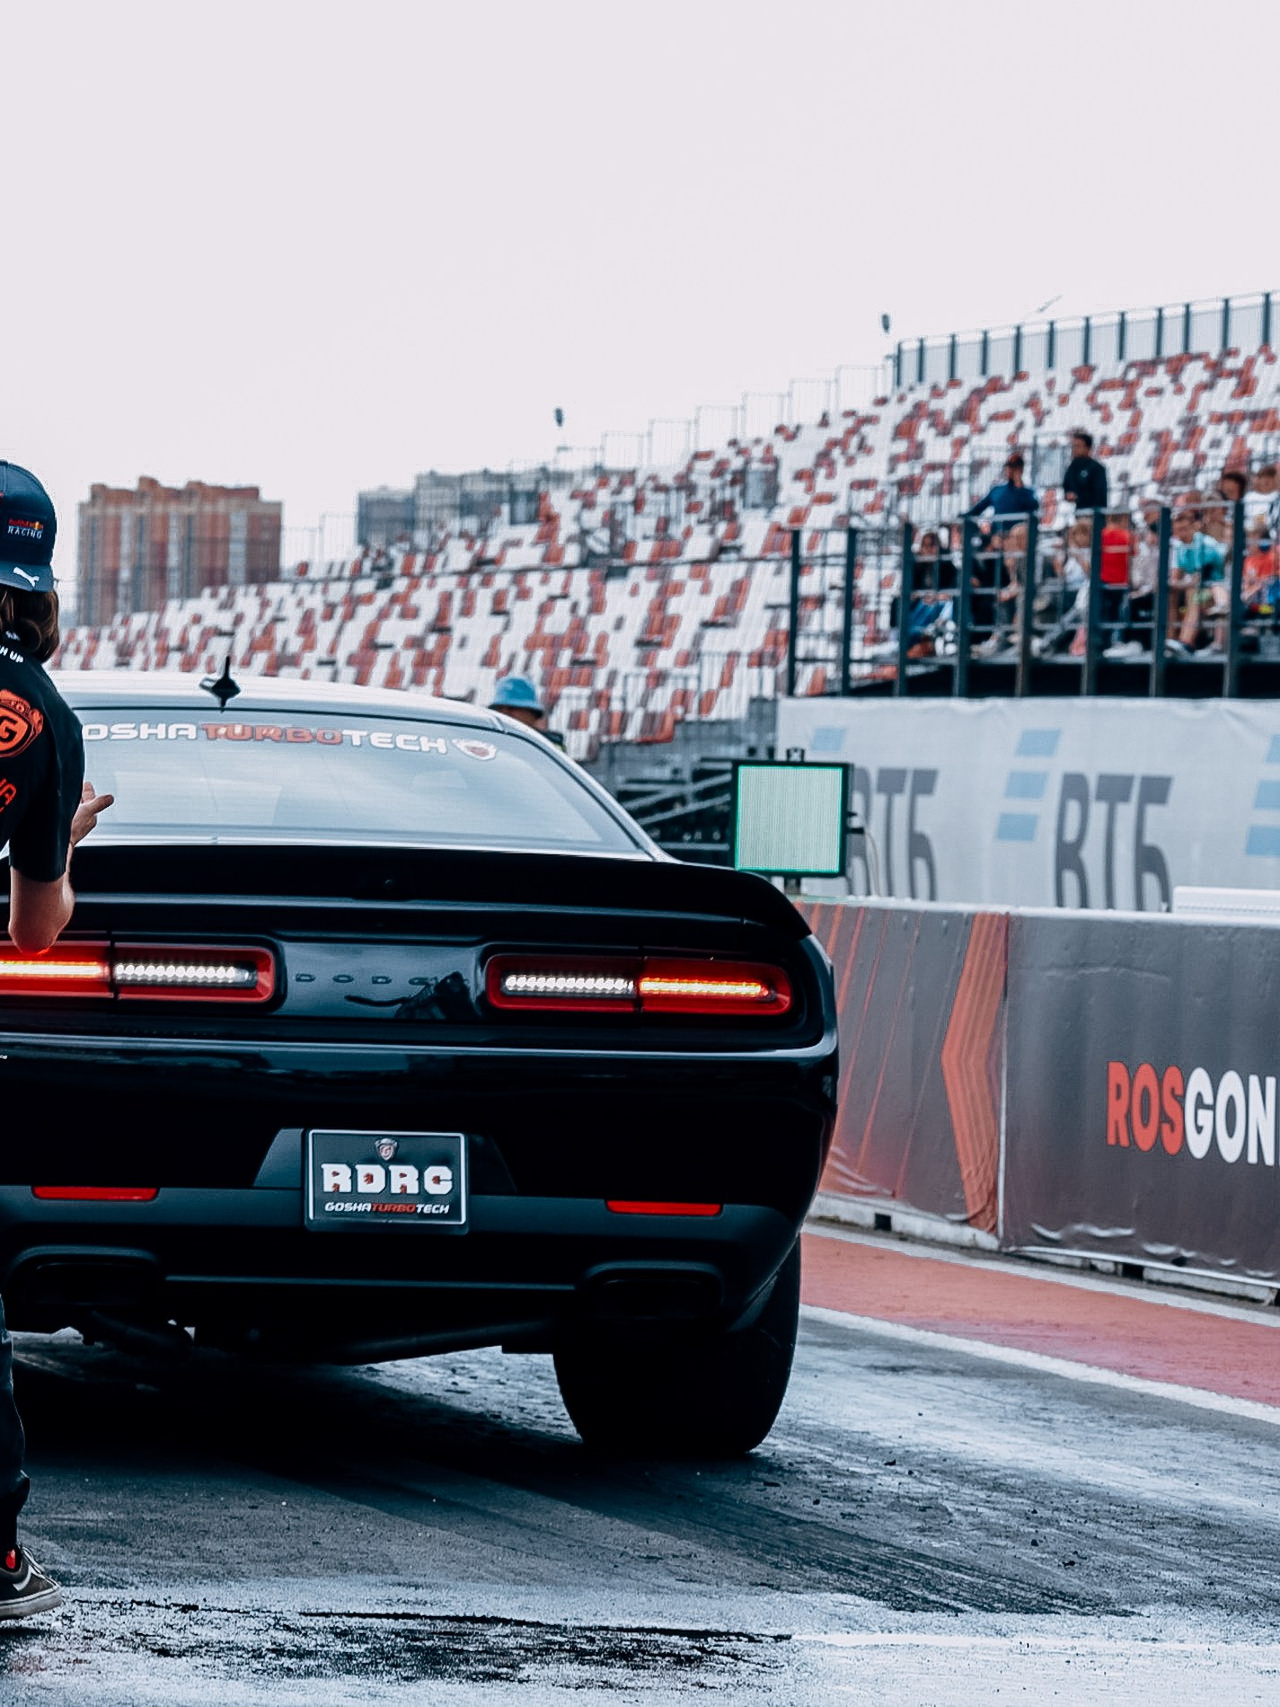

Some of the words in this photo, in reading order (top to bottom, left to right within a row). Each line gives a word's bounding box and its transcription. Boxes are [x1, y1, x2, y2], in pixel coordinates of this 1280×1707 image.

[8, 525, 42, 539] RACING
[82, 722, 447, 755] OSHATURBOTECH
[1054, 773, 1173, 911] ВТБ
[295, 972, 468, 987] DODG
[1106, 1060, 1280, 1167] ROSGON
[324, 1201, 450, 1214] GOSHATURBOTECH
